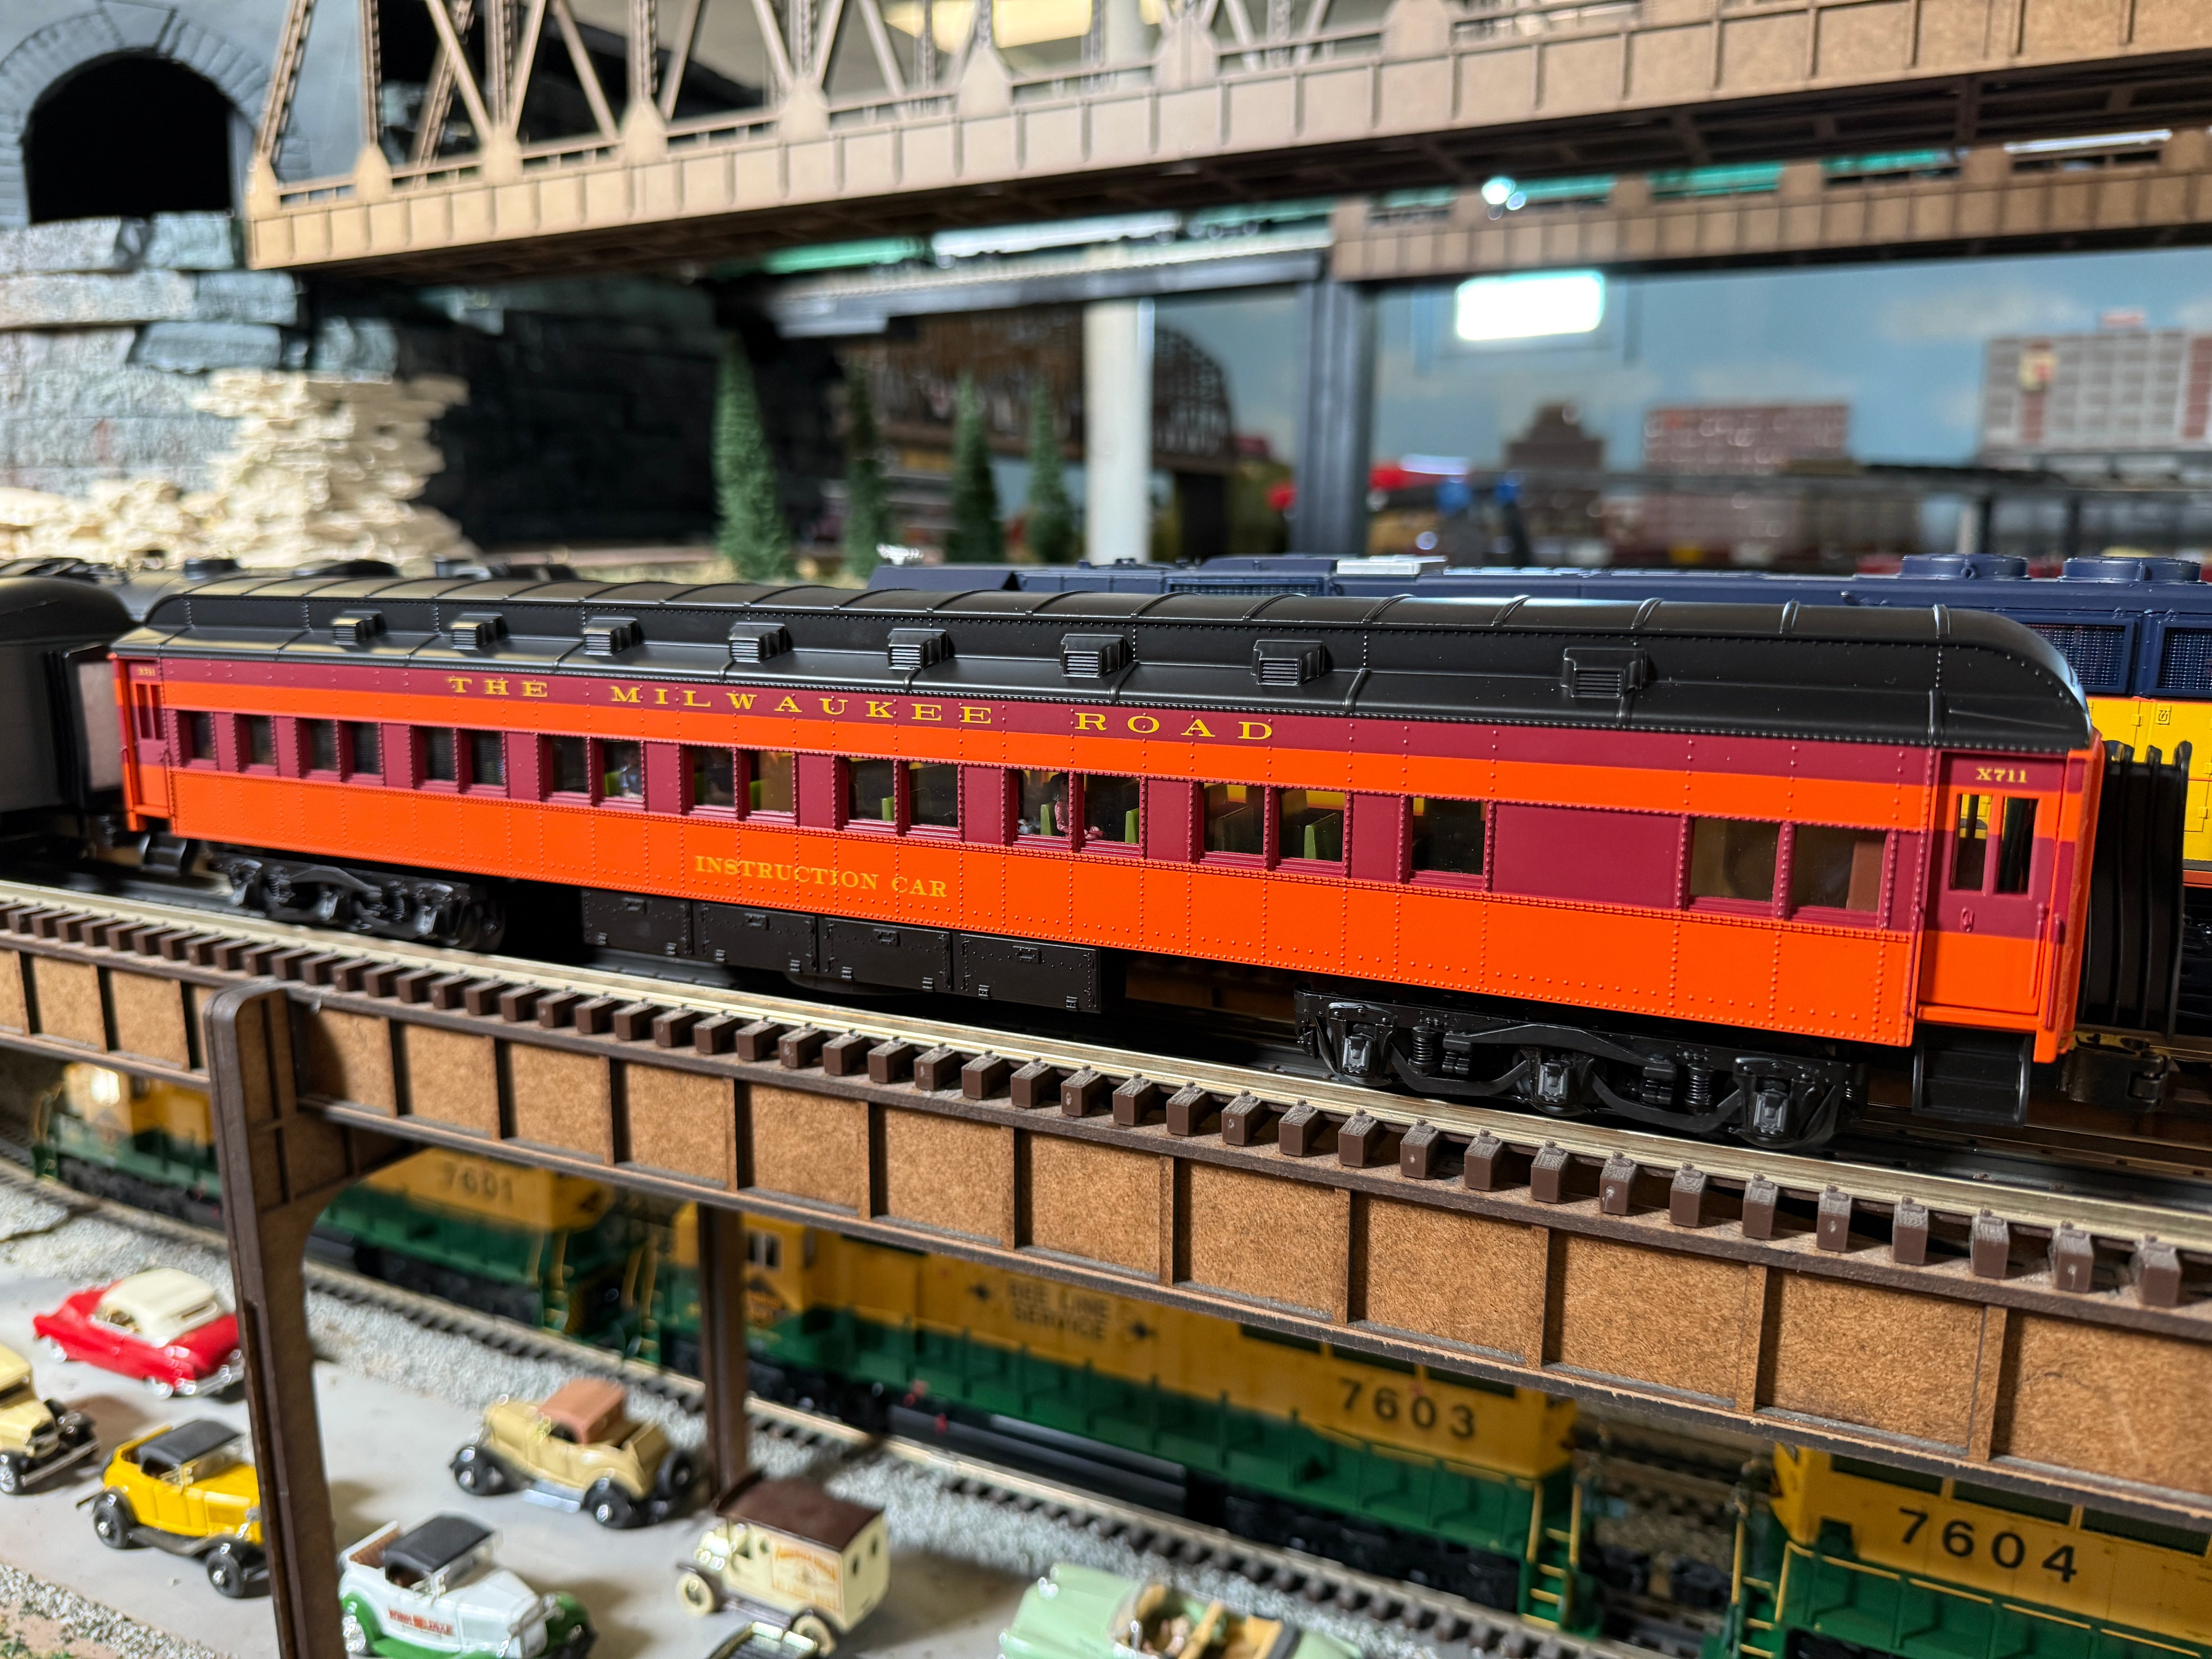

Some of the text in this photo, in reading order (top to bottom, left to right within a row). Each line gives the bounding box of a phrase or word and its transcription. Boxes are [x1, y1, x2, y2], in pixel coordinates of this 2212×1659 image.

[447, 678, 1273, 740] THE MILWAUKEE ROAD
[1976, 767, 2027, 783] X711
[694, 855, 948, 898] INSTRUCTION CAR
[442, 1162, 514, 1202] 7601
[1339, 1377, 1475, 1438] 7603
[1898, 1507, 2077, 1584] 7604
